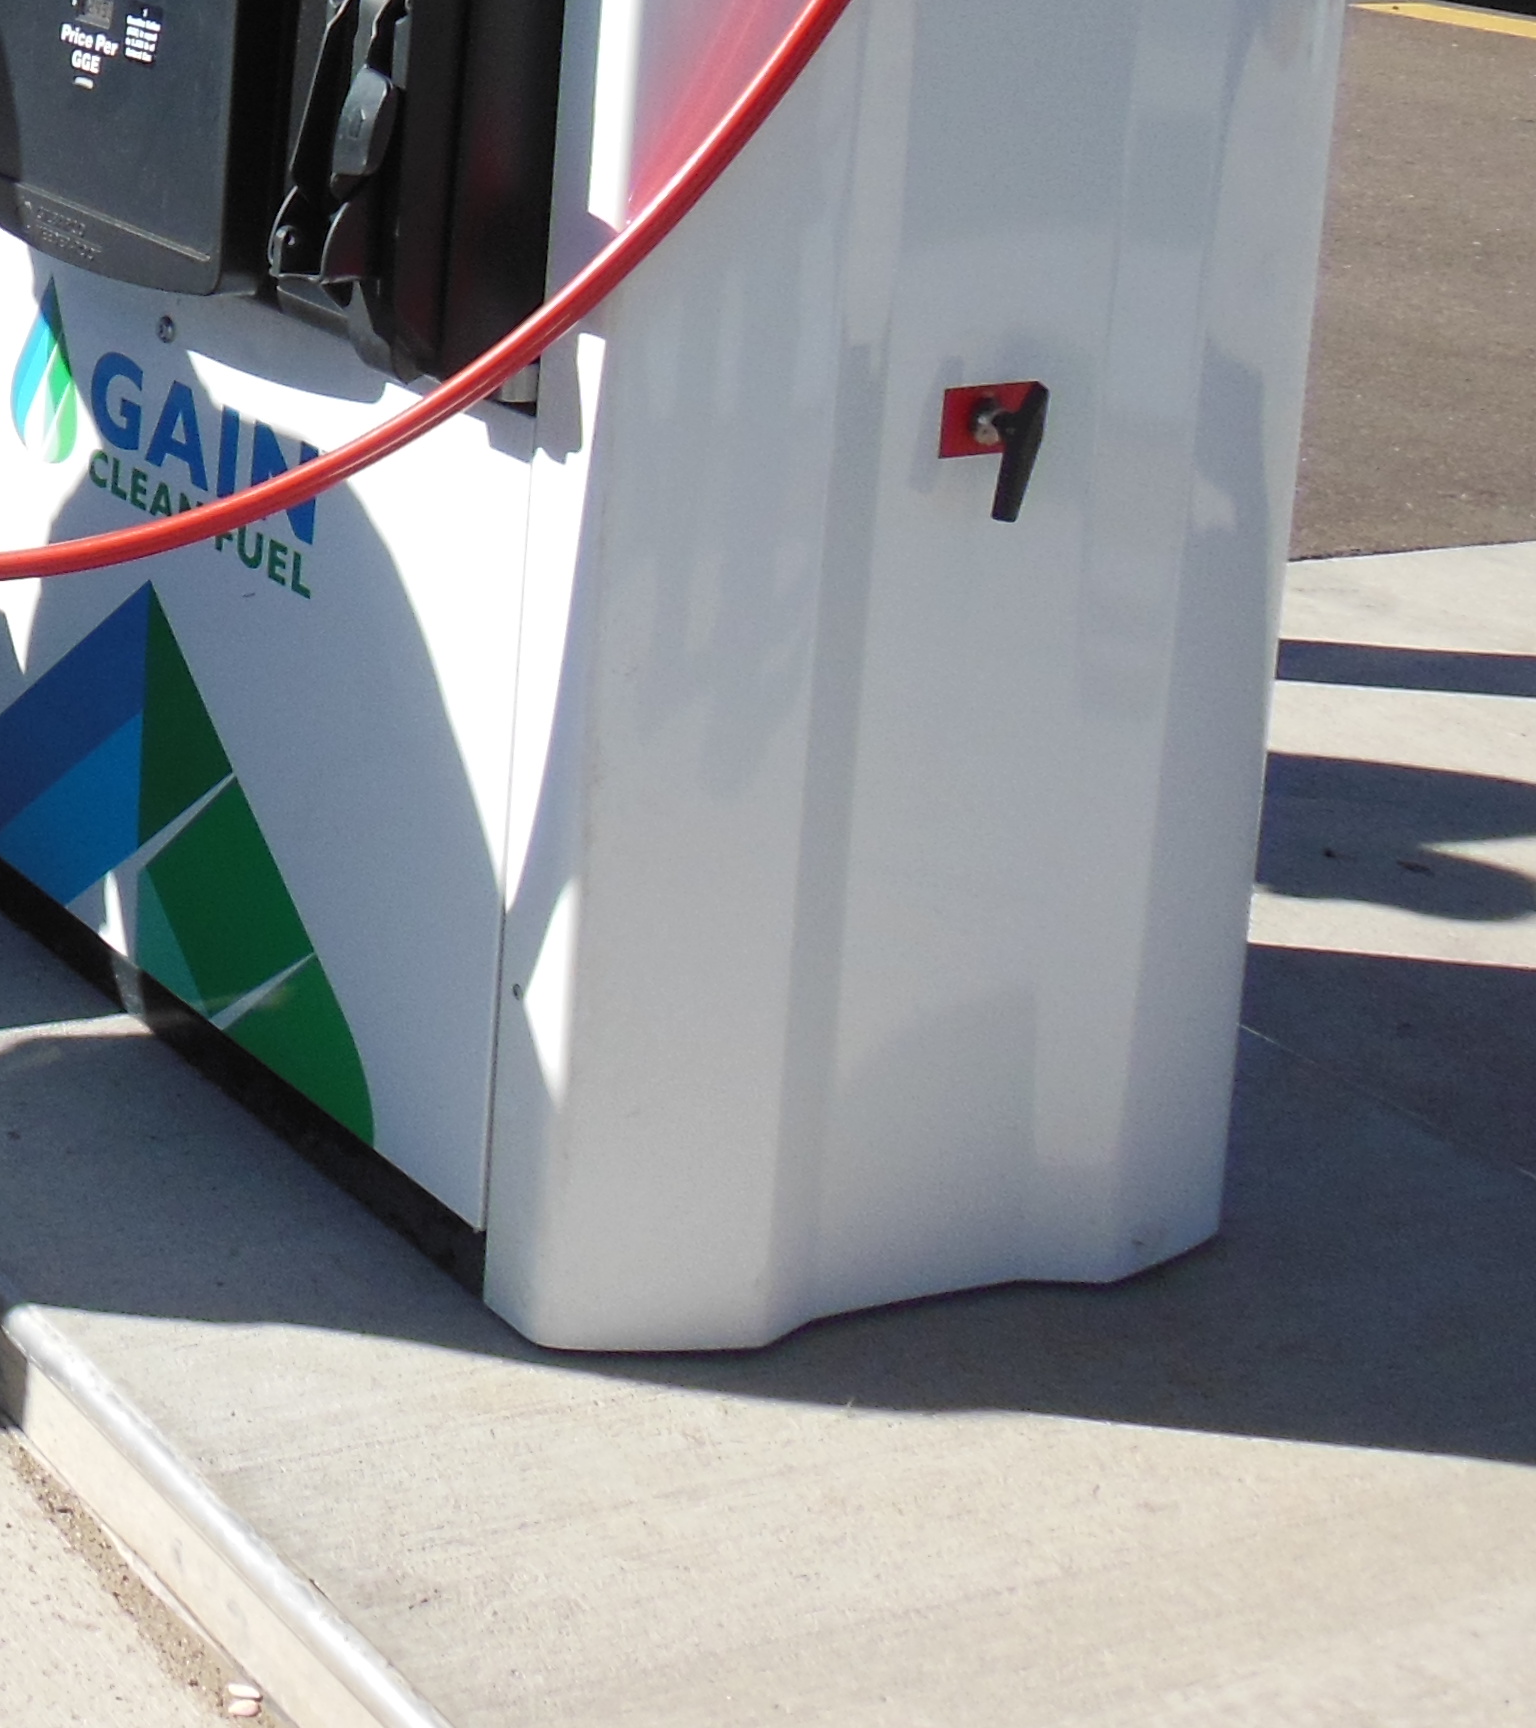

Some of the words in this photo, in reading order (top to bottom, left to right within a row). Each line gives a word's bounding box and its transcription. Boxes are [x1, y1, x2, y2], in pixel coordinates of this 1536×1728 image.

[60, 23, 94, 49] Price
[95, 33, 119, 56] Per
[71, 49, 101, 74] GGE
[91, 352, 320, 545] GAIN
